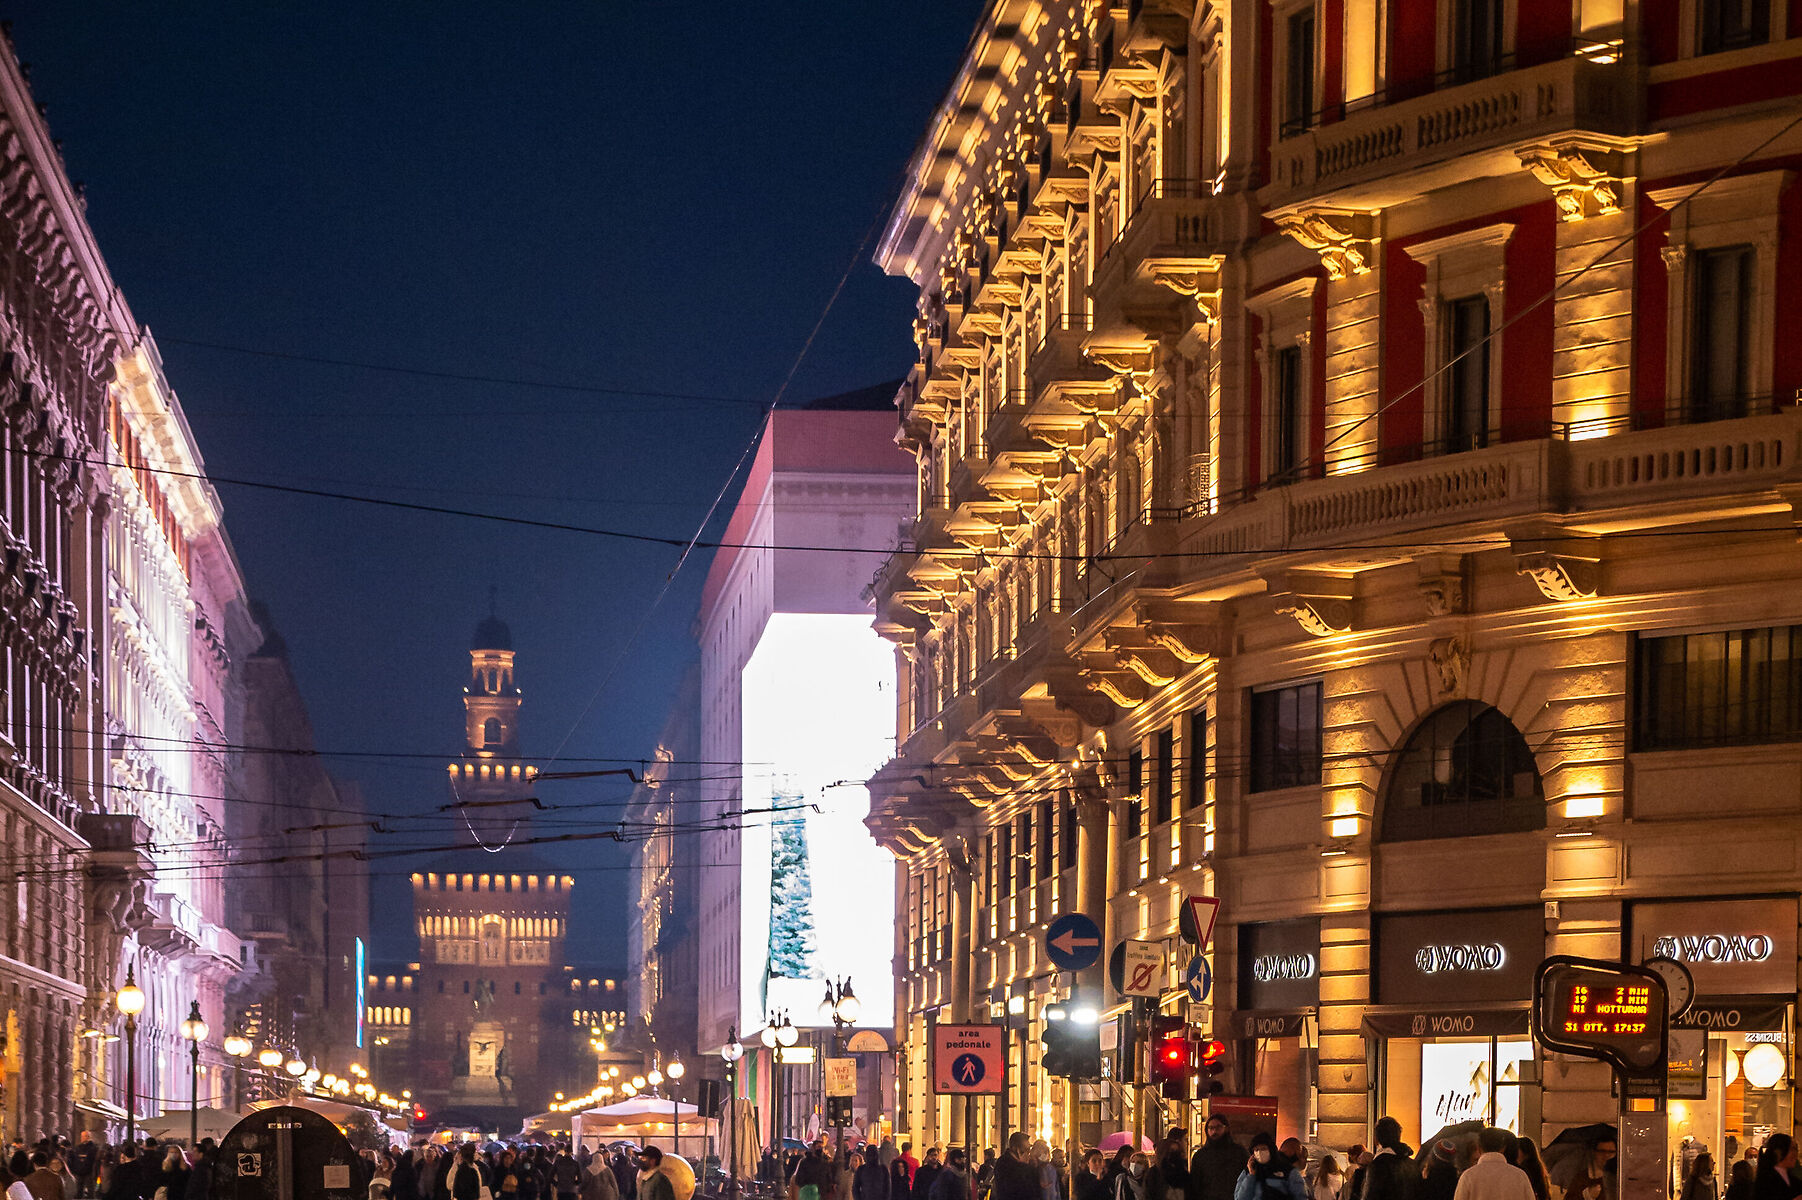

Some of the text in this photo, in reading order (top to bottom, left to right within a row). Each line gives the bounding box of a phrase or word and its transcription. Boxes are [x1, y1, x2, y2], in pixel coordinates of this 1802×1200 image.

[1681, 935, 1772, 962] WOMO
[1435, 944, 1504, 972] WOMO
[1267, 953, 1313, 979] WOMO
[1575, 986, 1649, 996] 16 2 MIN
[1574, 995, 1649, 1005] 19 4 MIN
[1596, 1005, 1647, 1014] NOTTURNA
[1257, 1017, 1285, 1034] WOMO
[1431, 1015, 1475, 1033] WOMO
[1684, 1010, 1741, 1027] WOMO
[958, 1030, 980, 1038] area
[1564, 1022, 1646, 1033] 31 OTT. 17:37
[946, 1040, 991, 1049] pedonale
